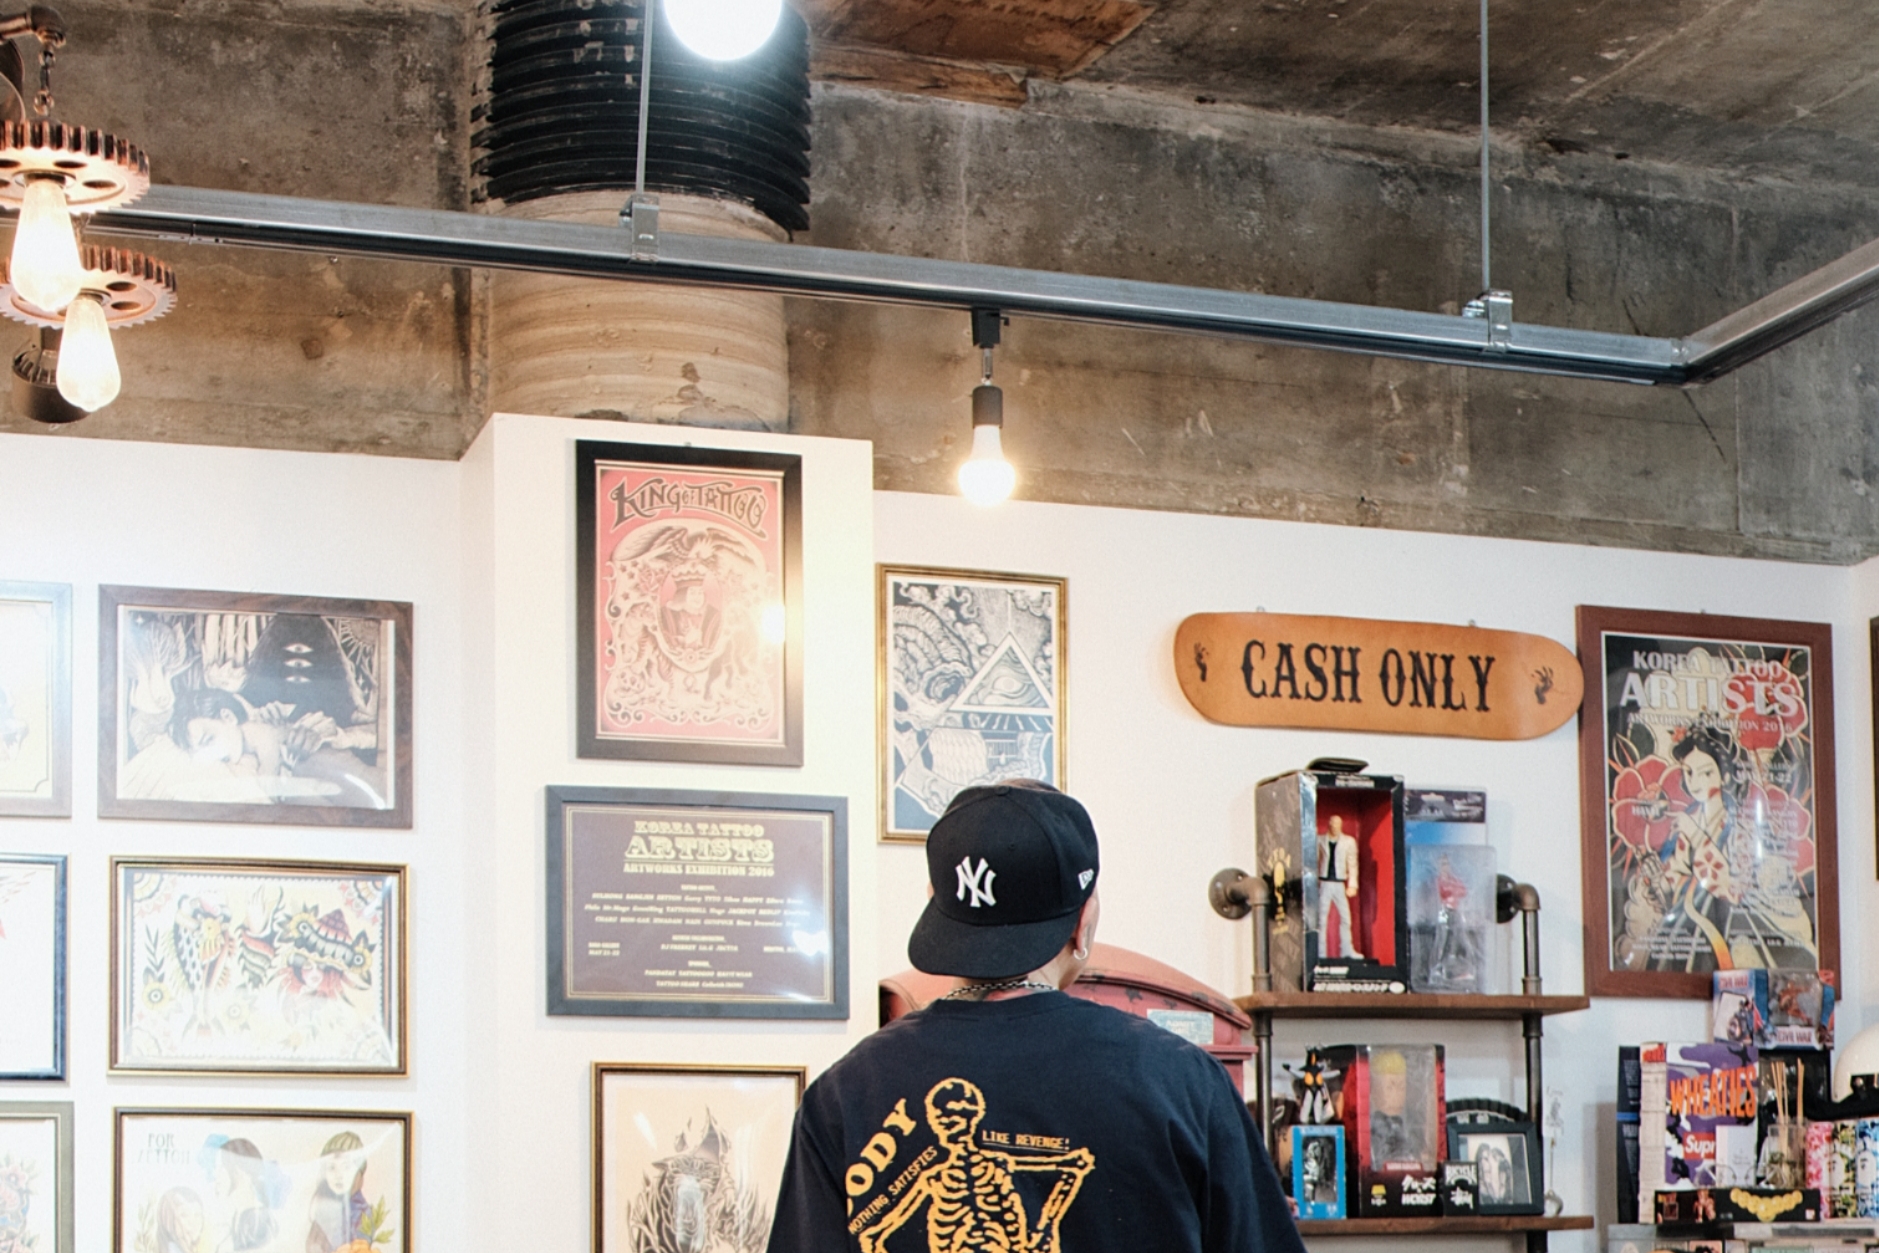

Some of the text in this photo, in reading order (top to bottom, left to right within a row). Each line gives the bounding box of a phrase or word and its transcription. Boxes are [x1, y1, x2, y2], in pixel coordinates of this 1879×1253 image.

[610, 478, 684, 530] KING
[1241, 639, 1496, 712] CASH ONLY
[1633, 651, 1784, 678] KOREA TATTOO
[1620, 672, 1799, 718] ARTISTS
[624, 834, 775, 863] ARTISTS
[634, 820, 764, 838] KOREA TATTOO
[623, 862, 775, 878] ARTWORKS EXHIBITION 2016
[955, 856, 997, 907] NY
[1670, 1065, 1757, 1118] WHEATIES
[148, 1133, 175, 1149] FOR
[845, 1098, 917, 1217] ODY
[982, 1129, 1070, 1151] LIKE REVENGE!
[848, 1145, 938, 1236] NOTHING SATISFIES
